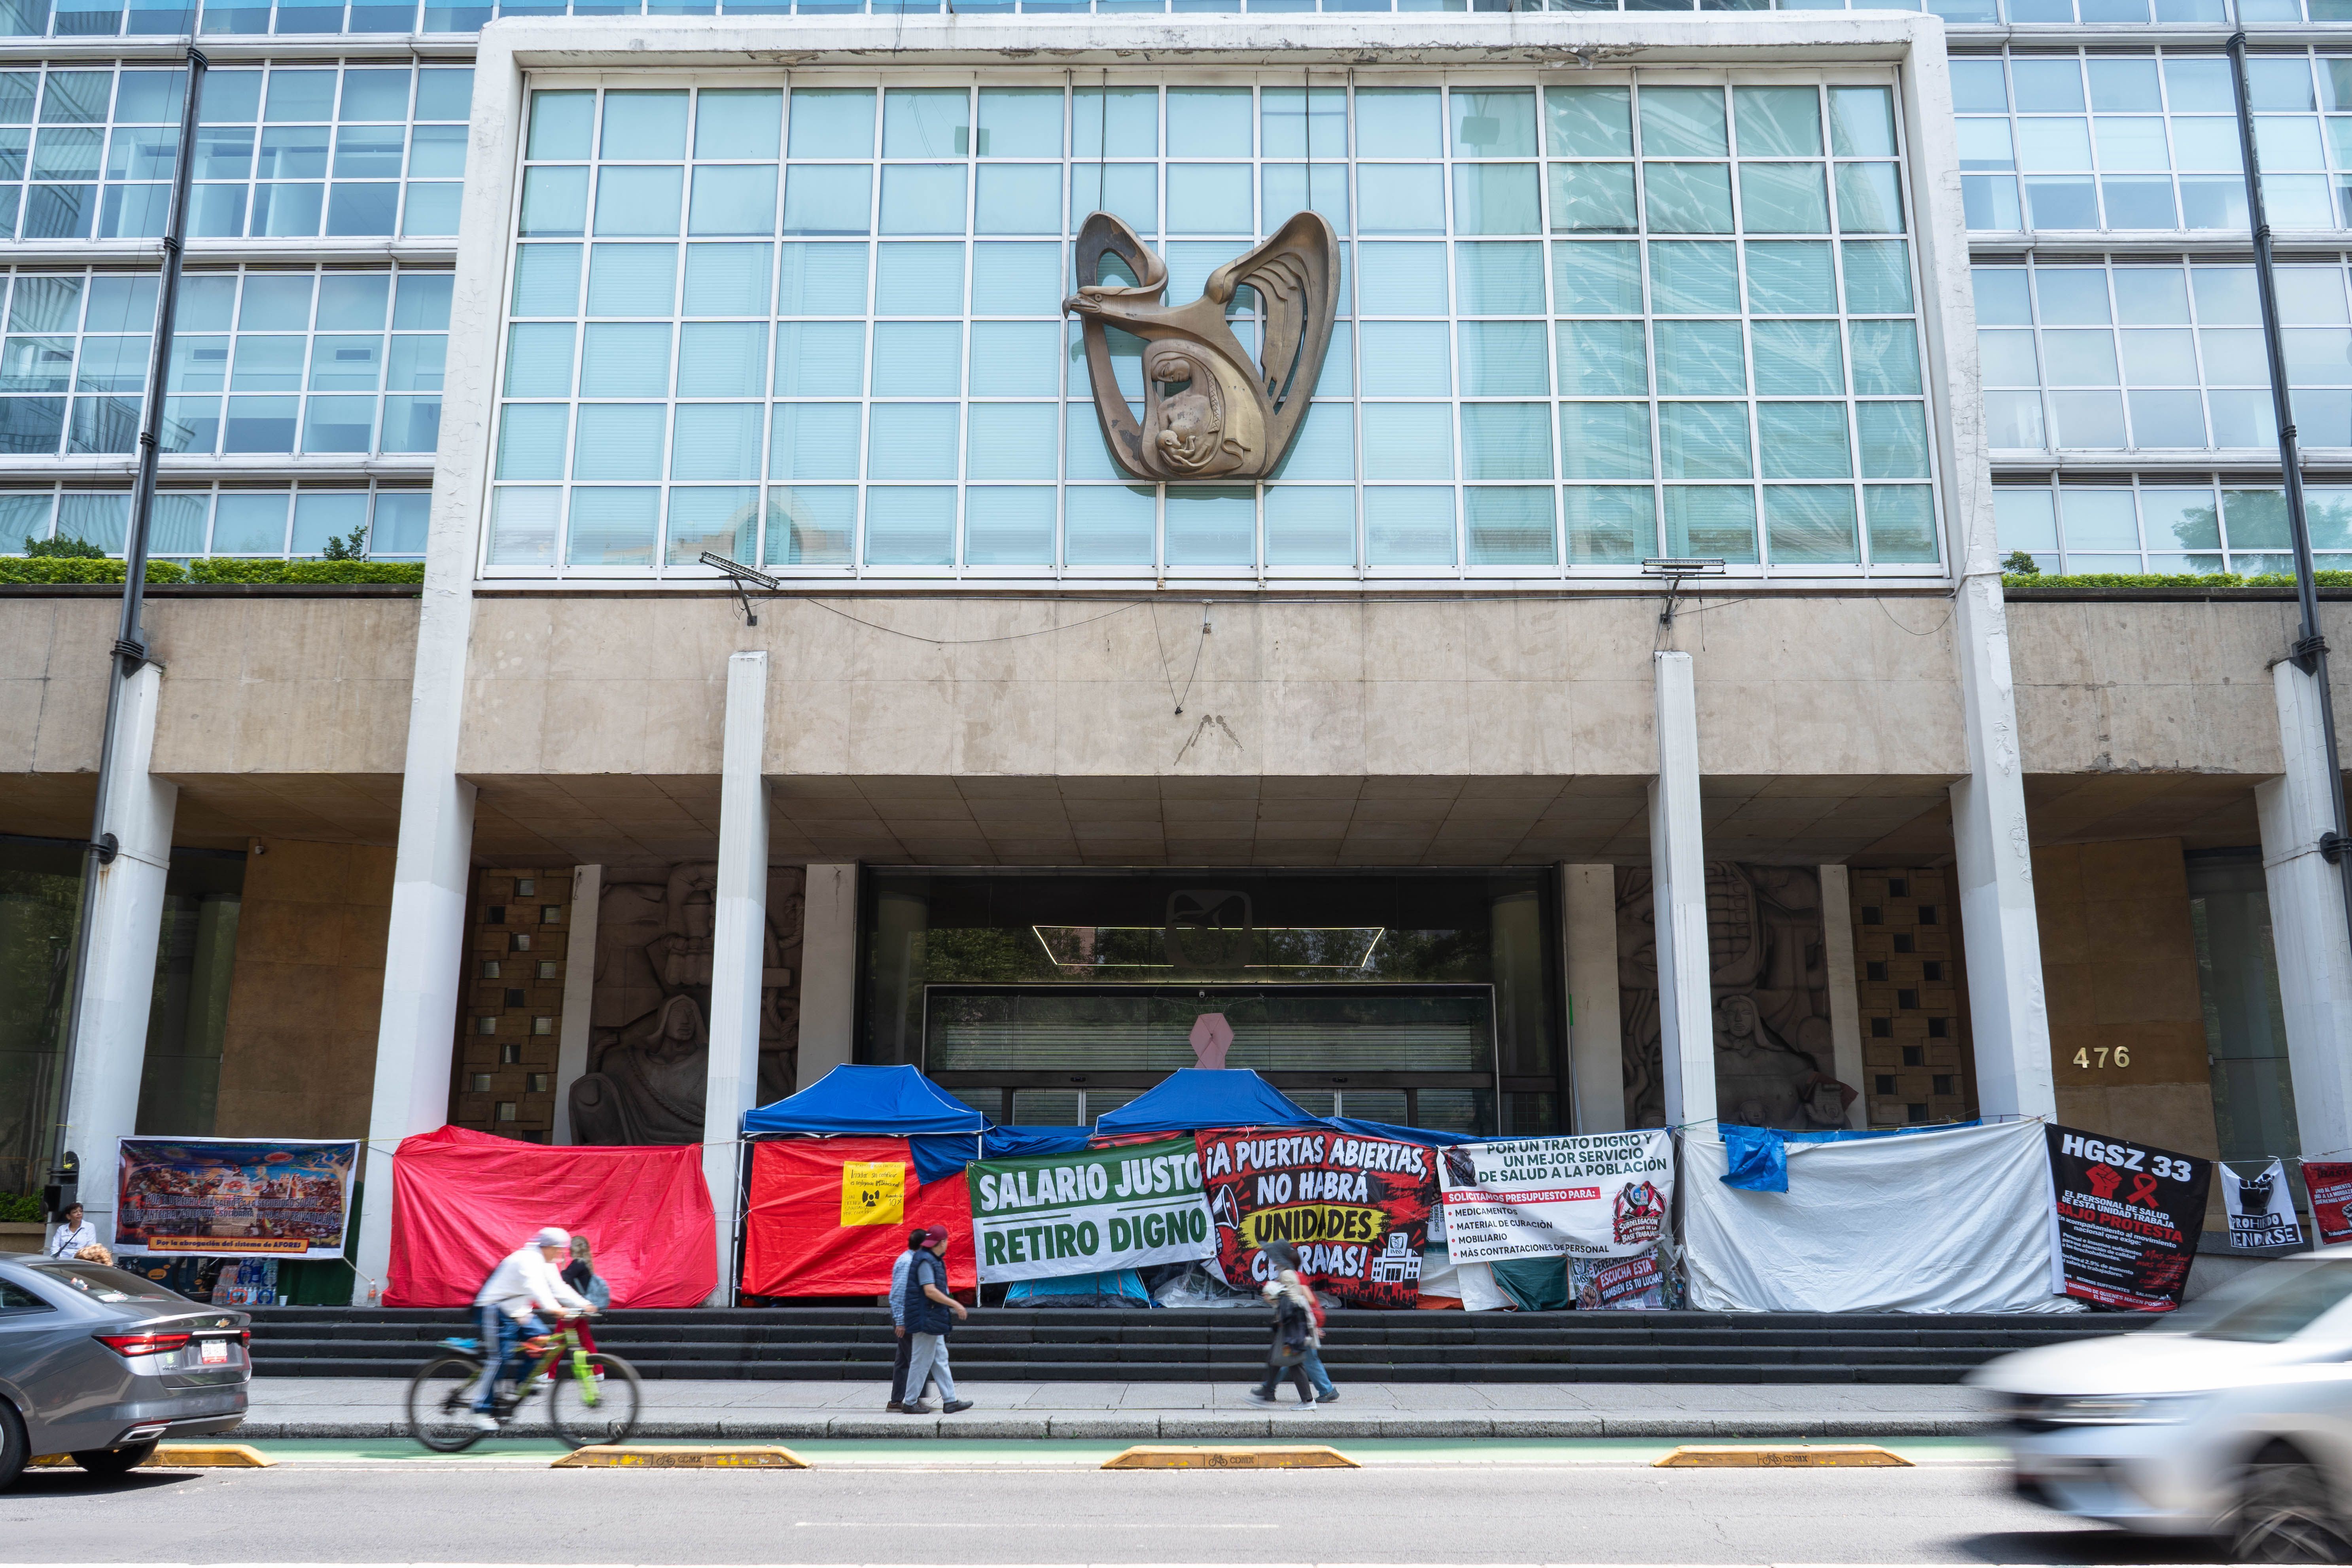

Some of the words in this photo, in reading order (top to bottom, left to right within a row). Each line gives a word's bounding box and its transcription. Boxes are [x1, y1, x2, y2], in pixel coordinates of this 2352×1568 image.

[2073, 1046, 2130, 1068] 476
[1486, 1142, 1516, 1154] POR
[1519, 1141, 1539, 1152] UN
[1543, 1138, 1589, 1151] TRATO
[1593, 1135, 1641, 1148] DIGNO
[1643, 1134, 1652, 1144] Y
[1207, 1142, 1231, 1180] ¡A
[1236, 1135, 1324, 1172] PUERTAS
[1329, 1138, 1427, 1181] ABIERTAS,
[1504, 1155, 1524, 1167] UN
[1527, 1152, 1576, 1166] MEJOR
[1579, 1147, 1644, 1163] SERVICIO
[2061, 1134, 2146, 1171] HGSZ
[2152, 1156, 2192, 1182] 33
[851, 1169, 868, 1178] Irradiar
[979, 1163, 1107, 1211] SALARIO
[1115, 1152, 1203, 1197] JUSTO
[1479, 1171, 1497, 1183] DE
[1501, 1168, 1547, 1182] SALUD
[1551, 1167, 1561, 1178] A
[1565, 1165, 1583, 1178] LA
[1258, 1173, 1292, 1205] NO
[1299, 1170, 1368, 1203] HABRÁ
[1449, 1192, 1504, 1202] SOLICITAMOS
[1505, 1191, 1567, 1203] PRESUPUESTO
[1569, 1189, 1595, 1199] PARA:
[2331, 1183, 2351, 1192] AUMENTO
[147, 1193, 160, 1205] POR
[162, 1194, 168, 1205] EL
[169, 1194, 200, 1207] DERECHO
[205, 1198, 213, 1207] LA
[215, 1198, 235, 1207] SALUD
[257, 1198, 294, 1208] SEGURIDAD
[296, 1196, 318, 1207] SOCIAL
[2065, 1190, 2075, 1198] EL
[2077, 1193, 2124, 1210] PERSONAL
[2125, 1204, 2138, 1213] DE
[2139, 1208, 2169, 1220] SALUD
[265, 1210, 273, 1219] NO
[280, 1211, 290, 1220] SU
[1455, 1207, 1518, 1217] MEDICAMENTOS
[2057, 1201, 2095, 1222] BAJO
[2099, 1212, 2183, 1243] PROTESTA
[2062, 1195, 2071, 1204] DE
[2073, 1199, 2096, 1210] ESTA
[2097, 1205, 2131, 1218] UNIDAD
[2133, 1213, 2174, 1229] TRABAJA
[2232, 1214, 2279, 1228] PROHIBIDO
[1255, 1207, 1372, 1243] UNIDADES
[1457, 1220, 1497, 1230] MATERIAL
[1619, 1216, 1658, 1233] SUBDELEGACIÓN
[2065, 1218, 2124, 1236] acompañamiento
[2133, 1234, 2177, 1248] movimiento
[984, 1220, 1099, 1266] RETIRO
[1108, 1207, 1207, 1252] DIGNO
[1459, 1233, 1507, 1244] MOBILIARIO
[1622, 1233, 1635, 1243] BASE
[2062, 1232, 2082, 1242] Personal
[2087, 1239, 2111, 1249] insumos
[2112, 1244, 2142, 1256] suficientes
[2074, 1226, 2104, 1237] nacional
[2120, 1235, 2142, 1246] exige:
[1480, 1244, 1553, 1256] CONTRATACIONES
[1565, 1244, 1609, 1253] PERSONAL
[2081, 1243, 2106, 1254] atención
[2115, 1250, 2136, 1260] calidad
[1574, 1274, 1589, 1284] IMSS
[1600, 1265, 1632, 1288] ESCUCHA
[1633, 1260, 1652, 1276] ESTA
[2087, 1265, 2123, 1278] trabajadores.
[2109, 1265, 2134, 1275] aumento
[1603, 1282, 1625, 1301] TAMBIÉN
[1626, 1281, 1633, 1292] ES
[1634, 1279, 1641, 1289] TU
[1642, 1272, 1663, 1289] LUCHA!!
[2068, 1282, 2092, 1293] DIGNIDAD
[2099, 1291, 2123, 1300] QUIENES
[2124, 1296, 2144, 1305] HACEN
[2077, 1276, 2097, 1285] RECURSOS
[2136, 1291, 2159, 1299] SALARIOS
